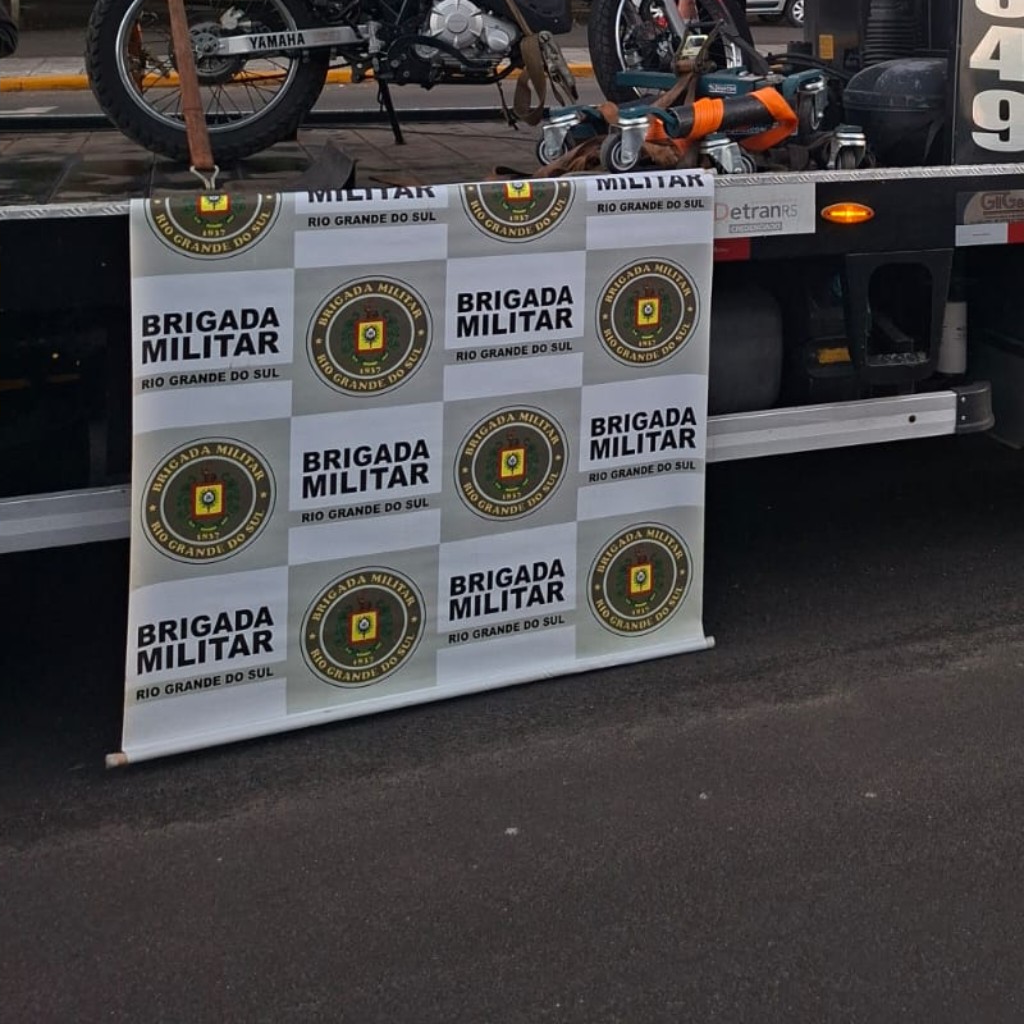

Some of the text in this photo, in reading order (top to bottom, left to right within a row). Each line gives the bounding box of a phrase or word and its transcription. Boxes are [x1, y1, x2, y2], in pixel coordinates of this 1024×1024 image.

[249, 33, 305, 49] YAMAHA
[308, 212, 436, 227] RIO GRANDE DO SUL
[598, 200, 704, 213] RIO GRANDE DO SUL
[458, 286, 573, 313] BRIGADA
[142, 307, 279, 336] BRIGADA
[457, 308, 572, 338] MILITAR
[142, 331, 279, 364] MILITAR
[456, 342, 572, 361] RIO GRANDE DO SUL
[142, 368, 279, 389] RIO GRANDE DO SUL
[591, 407, 696, 437] BRIGADA
[303, 440, 430, 473] BRIGADA
[590, 428, 696, 460] MILITAR
[303, 463, 428, 498] MILITAR
[589, 461, 696, 482] RIO GRANDE DO SUL
[302, 498, 429, 522] RIO GRANDE DO SUL
[450, 559, 565, 596] BRIGADA
[450, 581, 564, 621] MILITAR
[138, 606, 274, 648] BRIGADA
[448, 615, 564, 644] RIO GRANDE DO SUL
[138, 630, 273, 675] MILITAR
[136, 667, 274, 700] RIO GRANDE DO SUL
